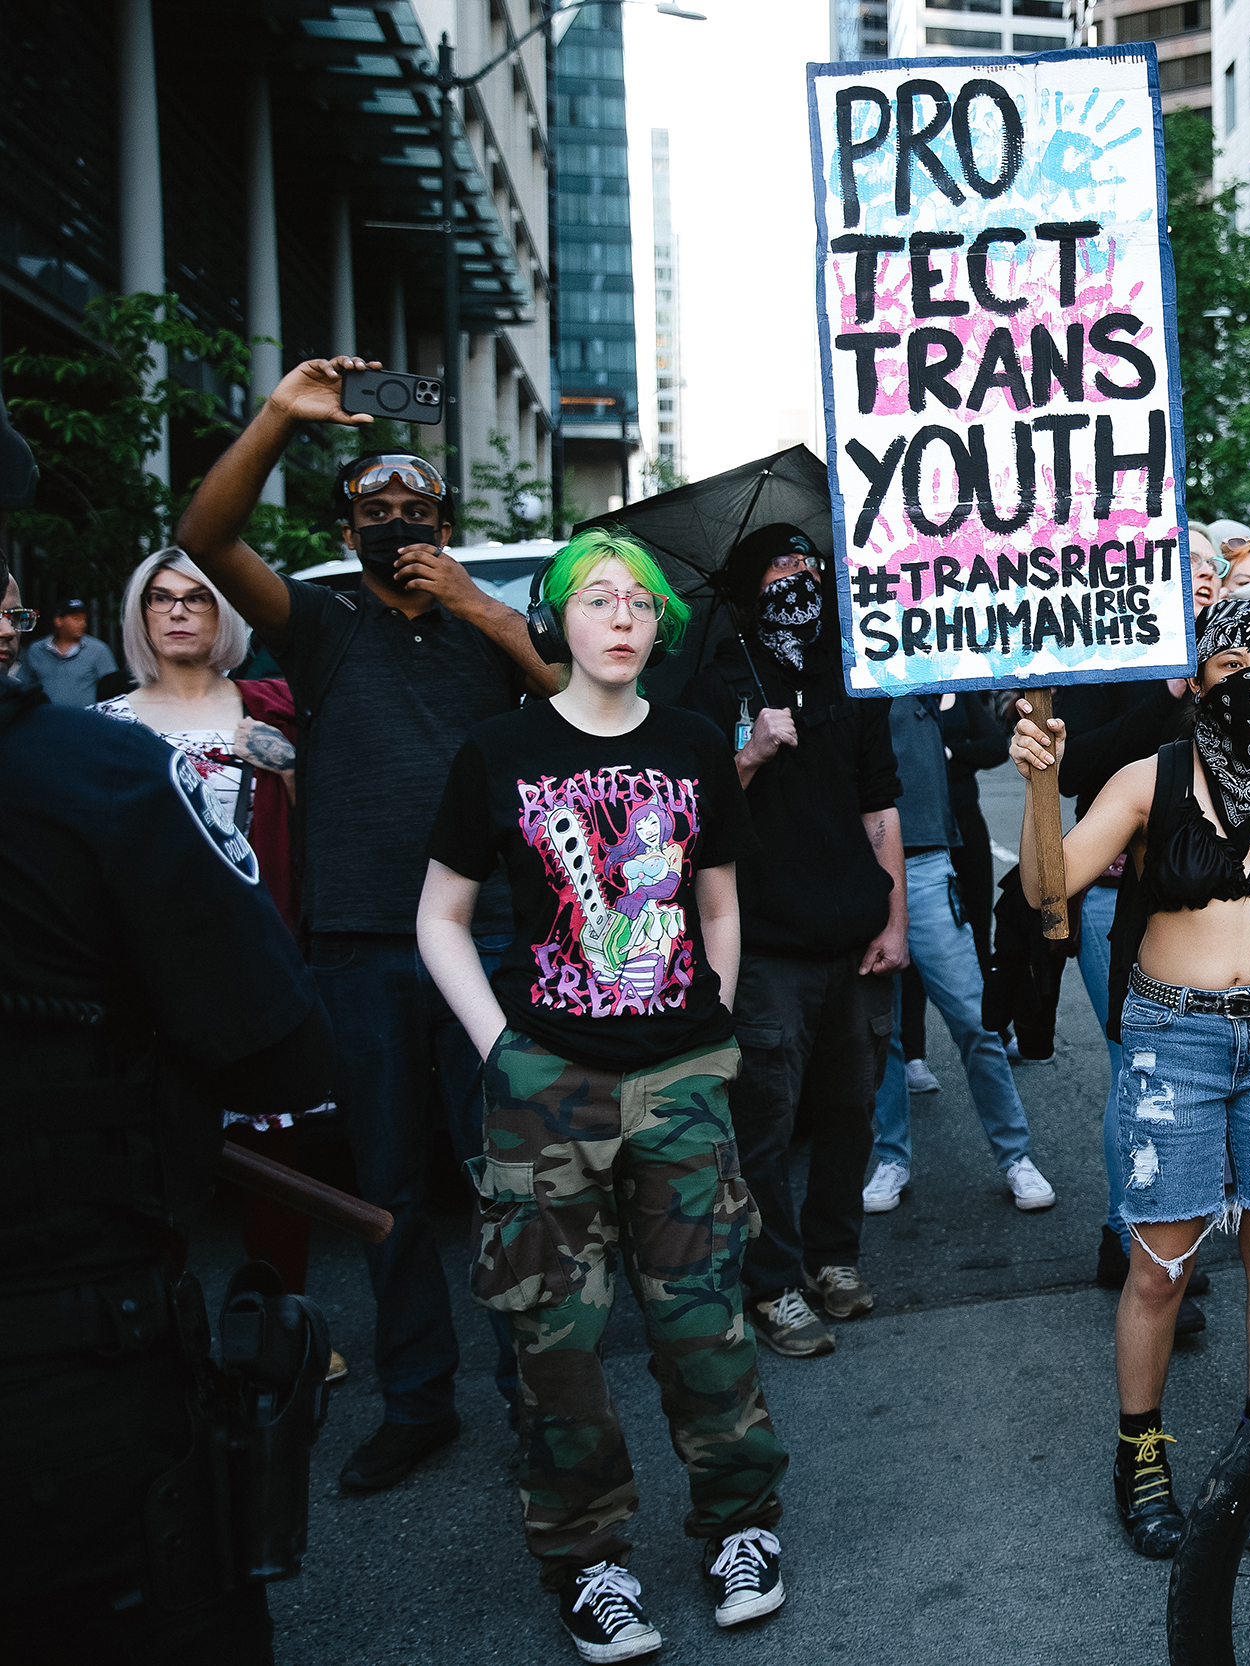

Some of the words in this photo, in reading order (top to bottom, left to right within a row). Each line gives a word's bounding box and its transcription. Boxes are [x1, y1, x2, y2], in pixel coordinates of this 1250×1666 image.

[836, 78, 1025, 228] PRO
[830, 220, 1101, 325] TECT
[834, 312, 1157, 415] TRANS
[844, 409, 1167, 548] YOUTH
[851, 539, 1178, 608] #TRANSRIGHT
[517, 764, 701, 847] BEAUTIFUL
[536, 942, 693, 1018] FREAKS
